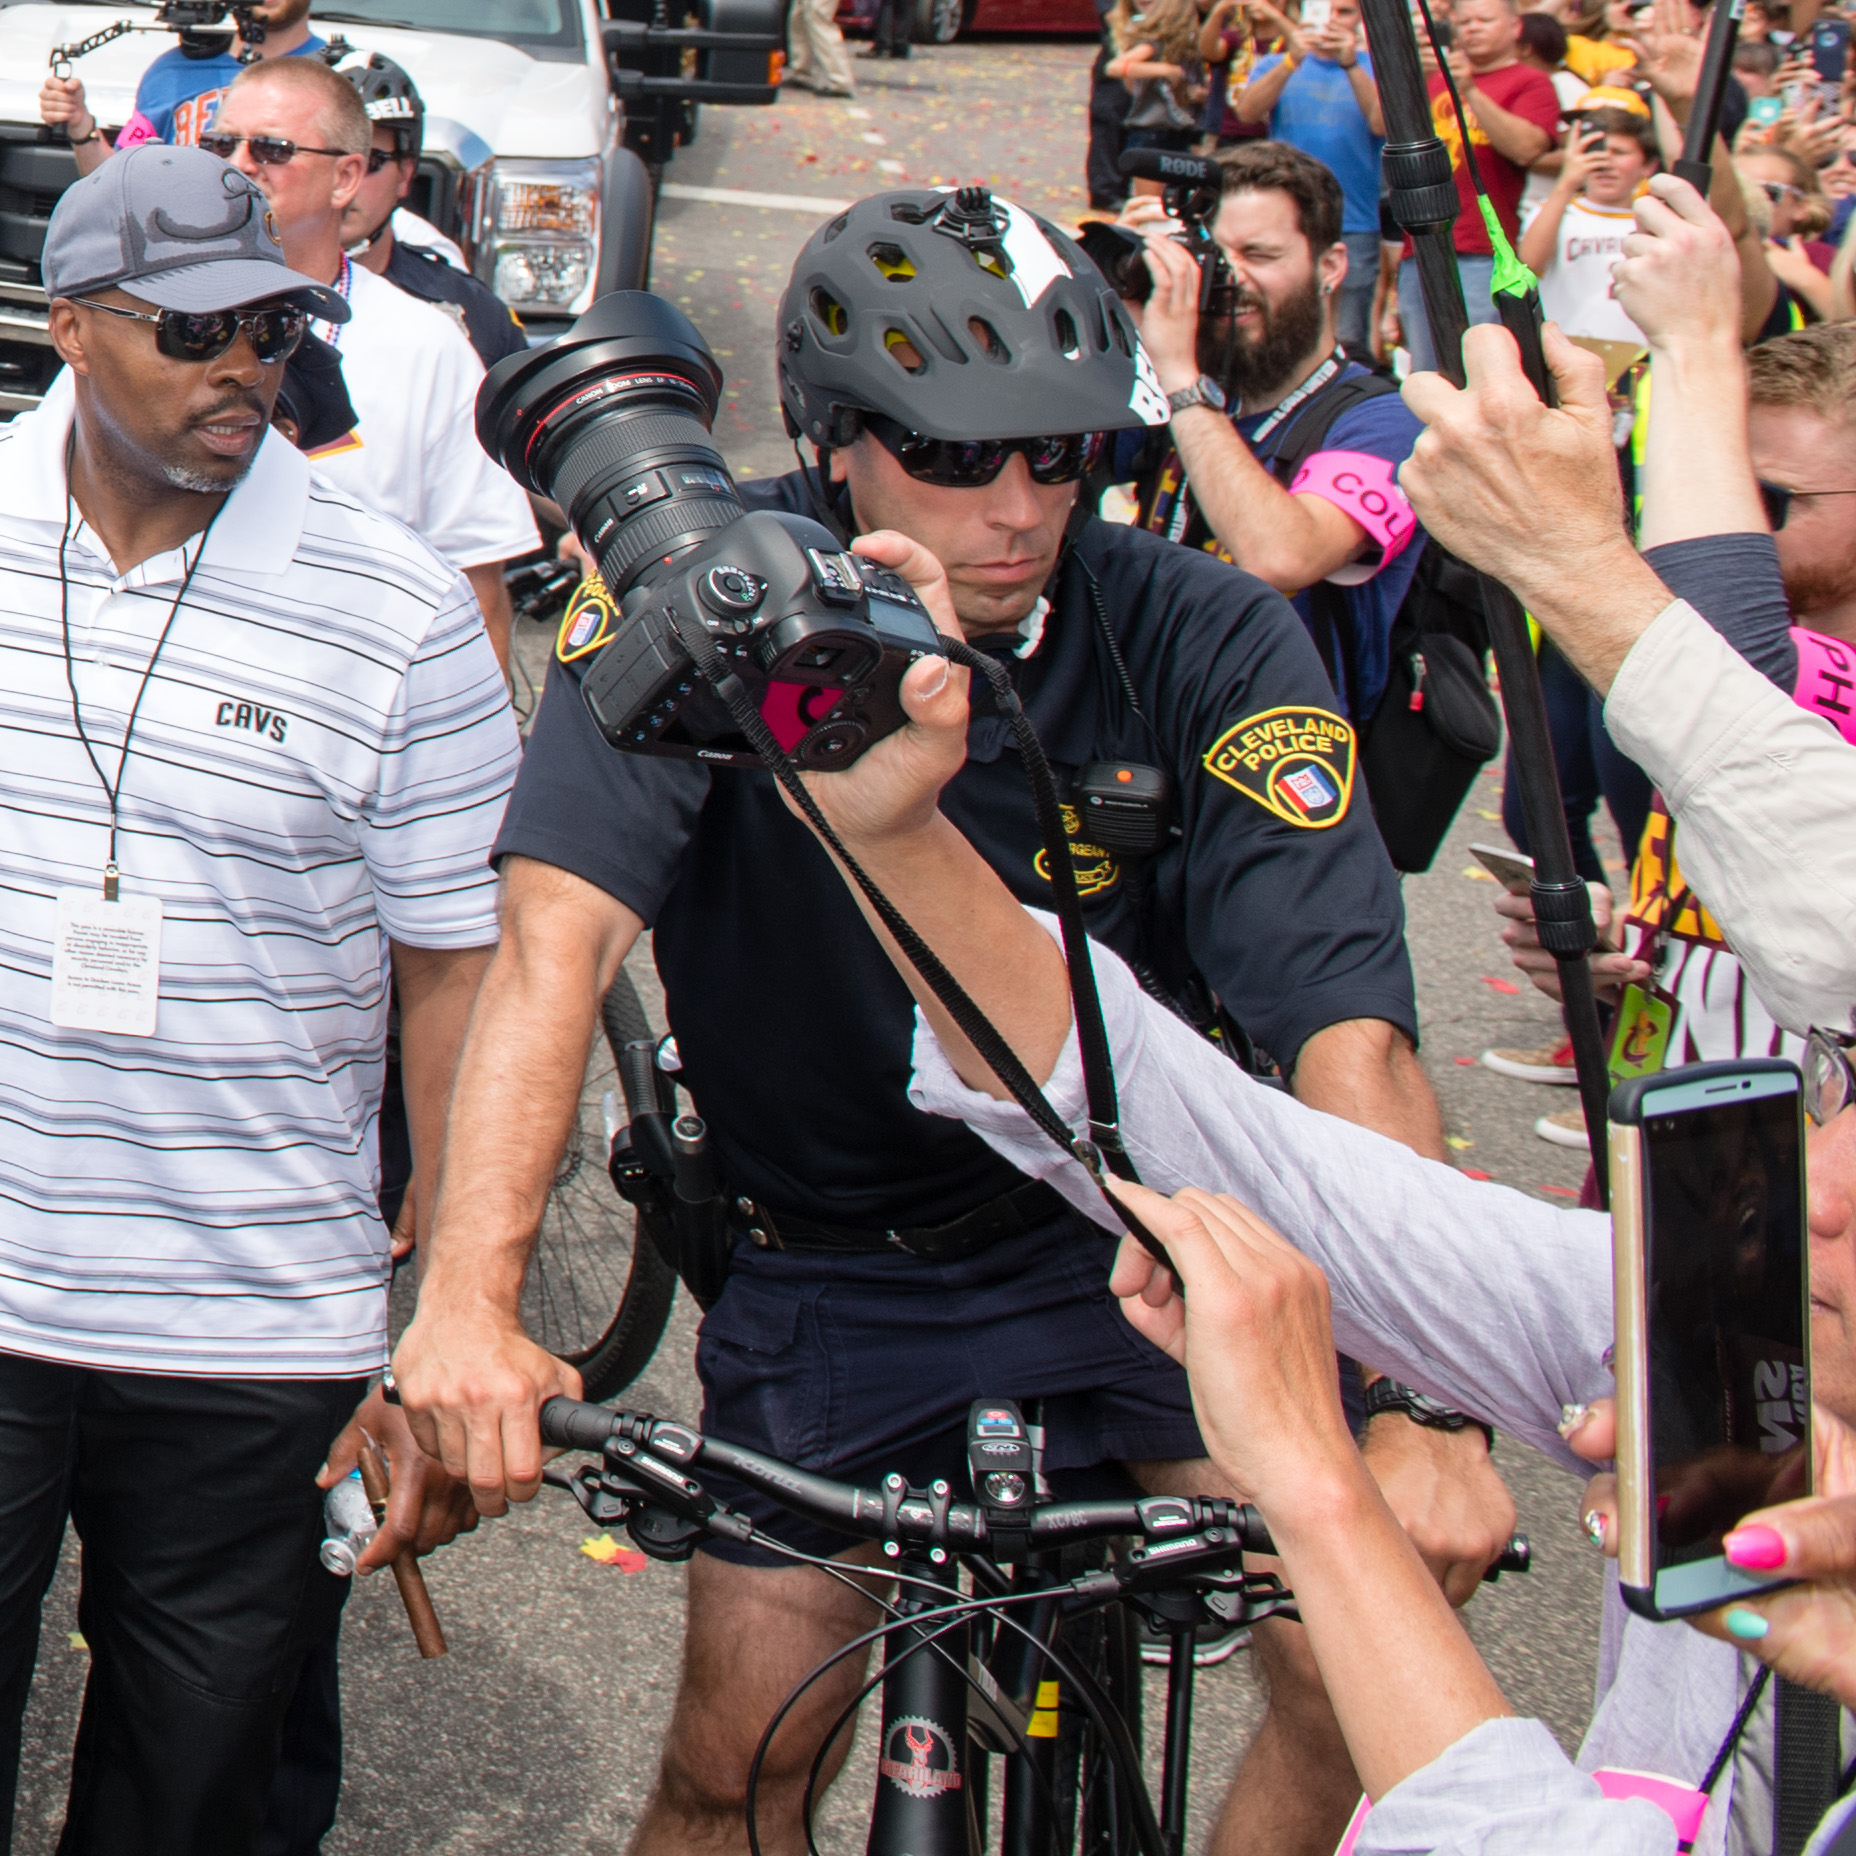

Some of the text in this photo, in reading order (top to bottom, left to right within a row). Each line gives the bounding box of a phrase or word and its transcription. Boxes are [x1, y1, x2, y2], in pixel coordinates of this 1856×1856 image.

[1159, 156, 1209, 178] RØDE
[574, 388, 604, 405] CANON
[634, 377, 652, 385] LENS
[215, 701, 289, 744] CAVS
[697, 749, 734, 760] Canon
[1214, 717, 1349, 773] CLEVELAND
[1241, 734, 1333, 772] POLICE
[639, 1455, 685, 1484] SHIMANO
[1147, 1538, 1197, 1557] SHIMANO
